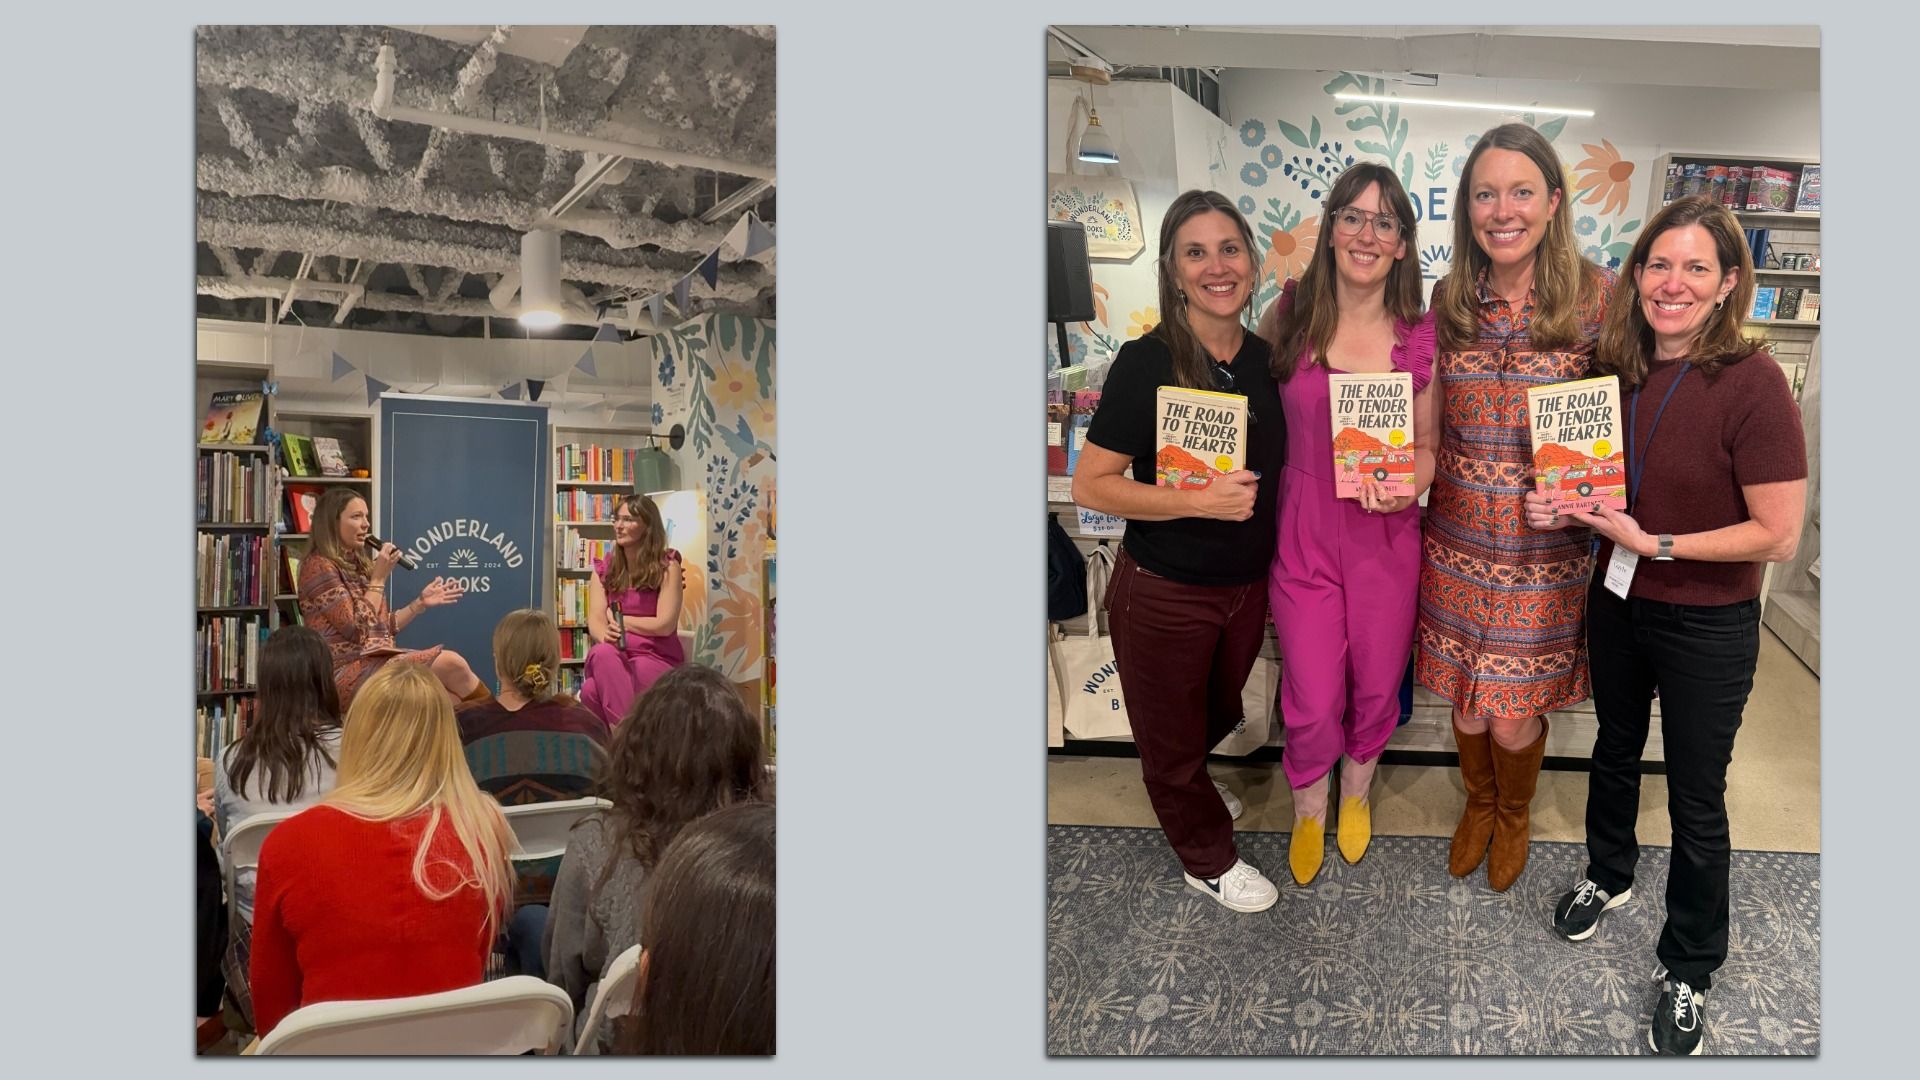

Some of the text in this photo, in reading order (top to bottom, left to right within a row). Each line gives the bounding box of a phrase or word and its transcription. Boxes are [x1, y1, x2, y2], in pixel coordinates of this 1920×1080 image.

[1069, 204, 1114, 225] WONDERLAND
[1340, 383, 1404, 399] THE ROAD
[1338, 399, 1408, 414] TO TENDER
[1537, 395, 1564, 414] THE
[1566, 390, 1608, 410] ROAD
[1166, 402, 1192, 419] THE
[1194, 406, 1235, 425] ROAD
[1357, 414, 1408, 429] HEARTS
[1535, 405, 1613, 430] TO TENDER
[1162, 416, 1180, 432] TO
[1184, 420, 1238, 441] TENDER
[1557, 422, 1613, 443] HEARTS
[1182, 434, 1237, 455] HEARTS
[405, 518, 524, 570] WONDERLAND
